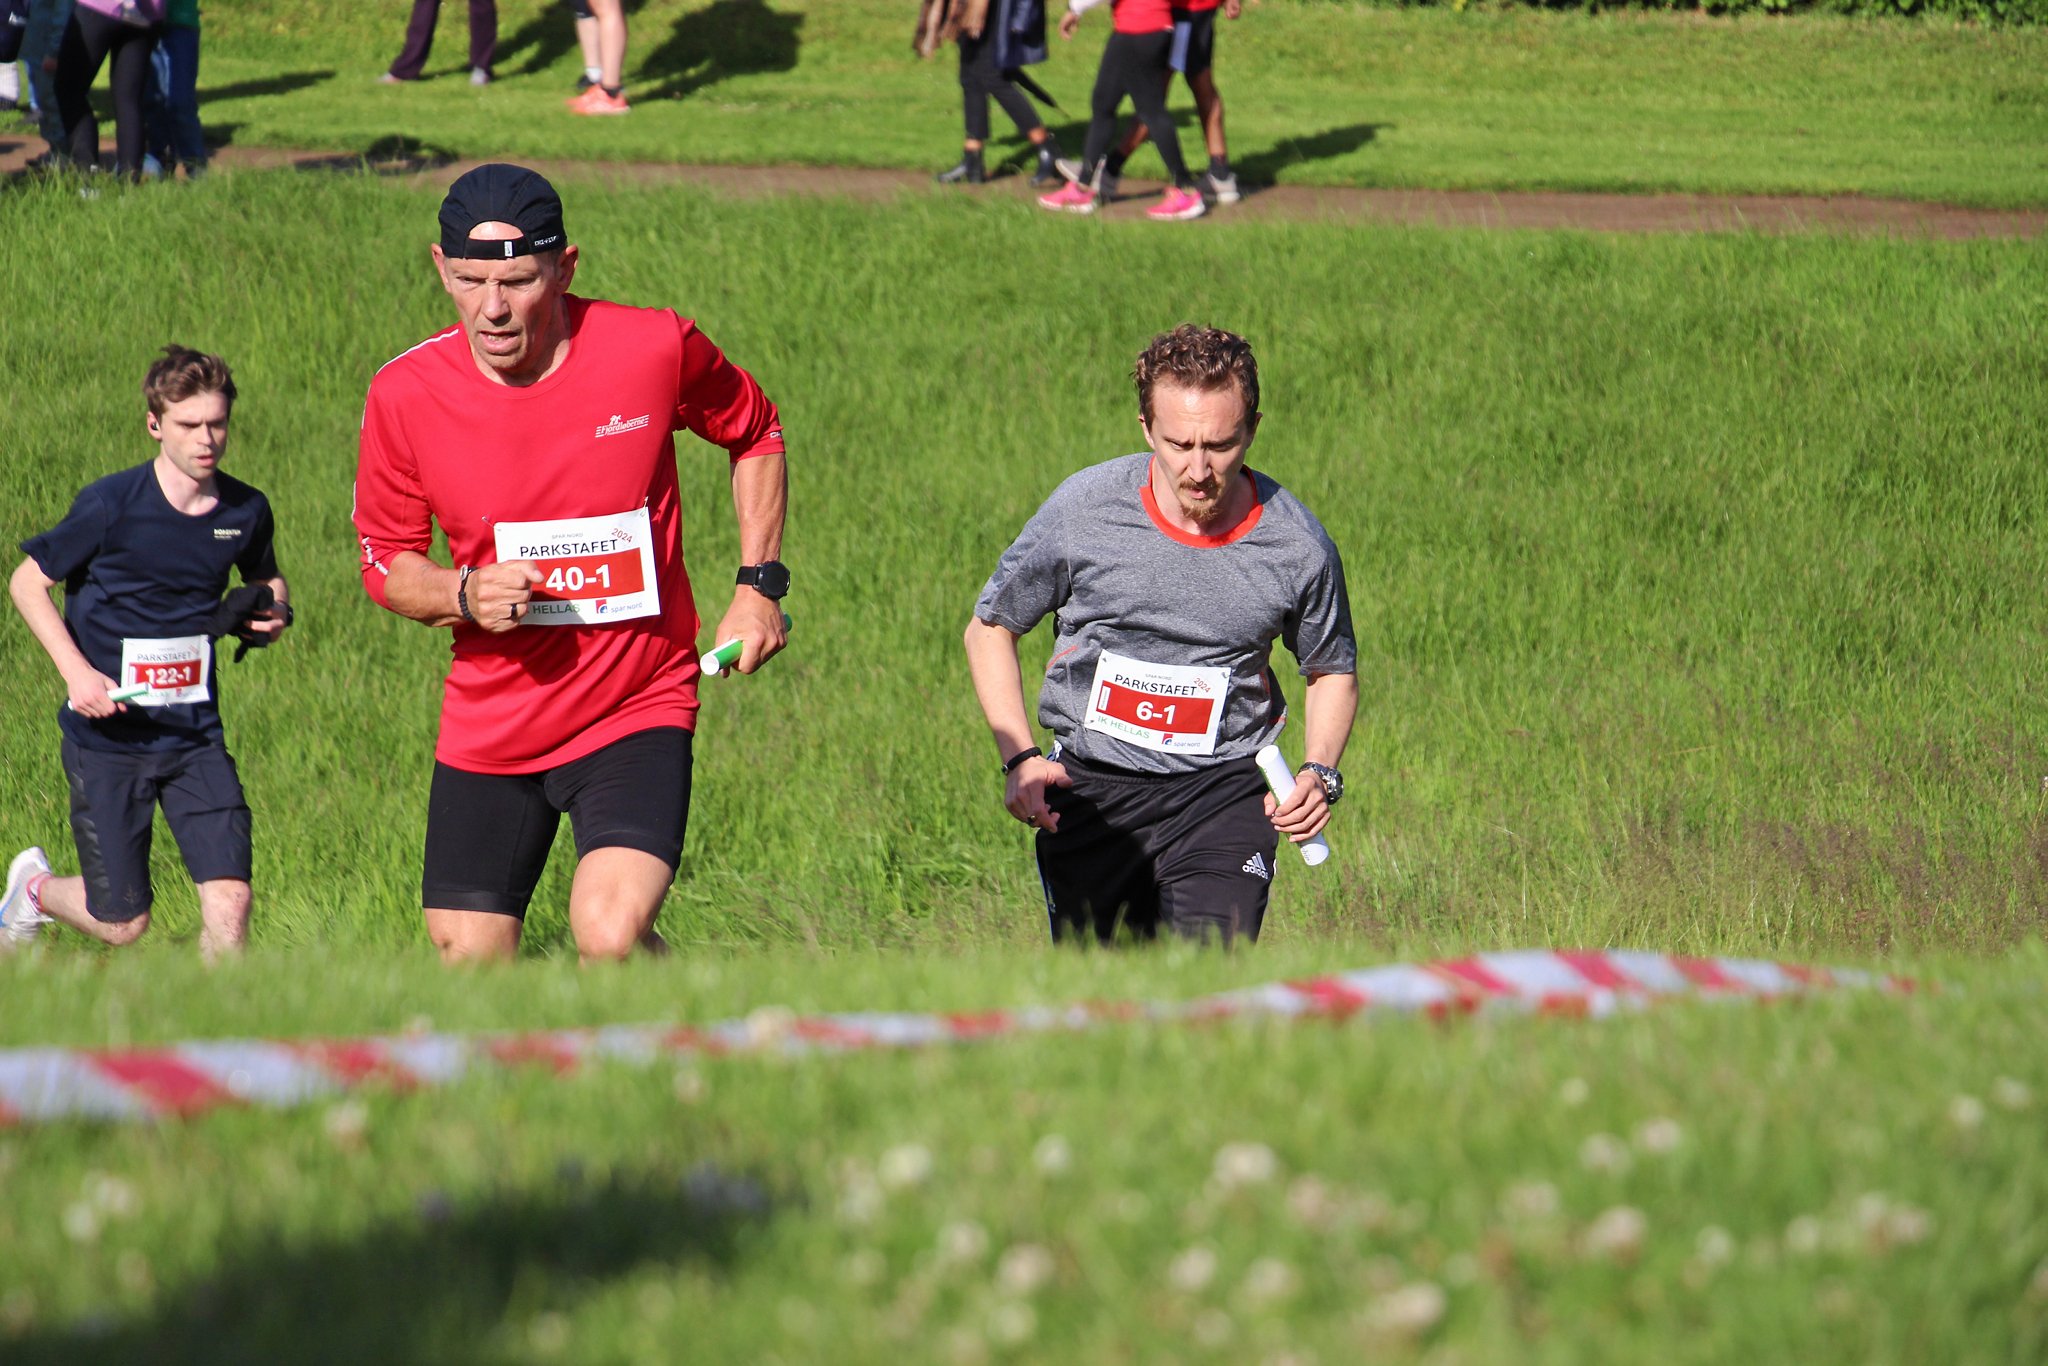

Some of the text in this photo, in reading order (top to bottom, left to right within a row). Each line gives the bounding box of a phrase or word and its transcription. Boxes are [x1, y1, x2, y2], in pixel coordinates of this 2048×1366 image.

[611, 527, 633, 543] 2024
[520, 538, 619, 558] PARKSTAFET
[545, 563, 611, 592] 40-1
[532, 603, 581, 615] HELLAS
[144, 666, 191, 685] 122-1
[1114, 673, 1197, 696] PARKSTAFET
[1193, 677, 1212, 694] 2024
[1135, 700, 1176, 725] 6-1
[1097, 715, 1151, 739] IK HELLAS
[1242, 864, 1268, 880] adidas
